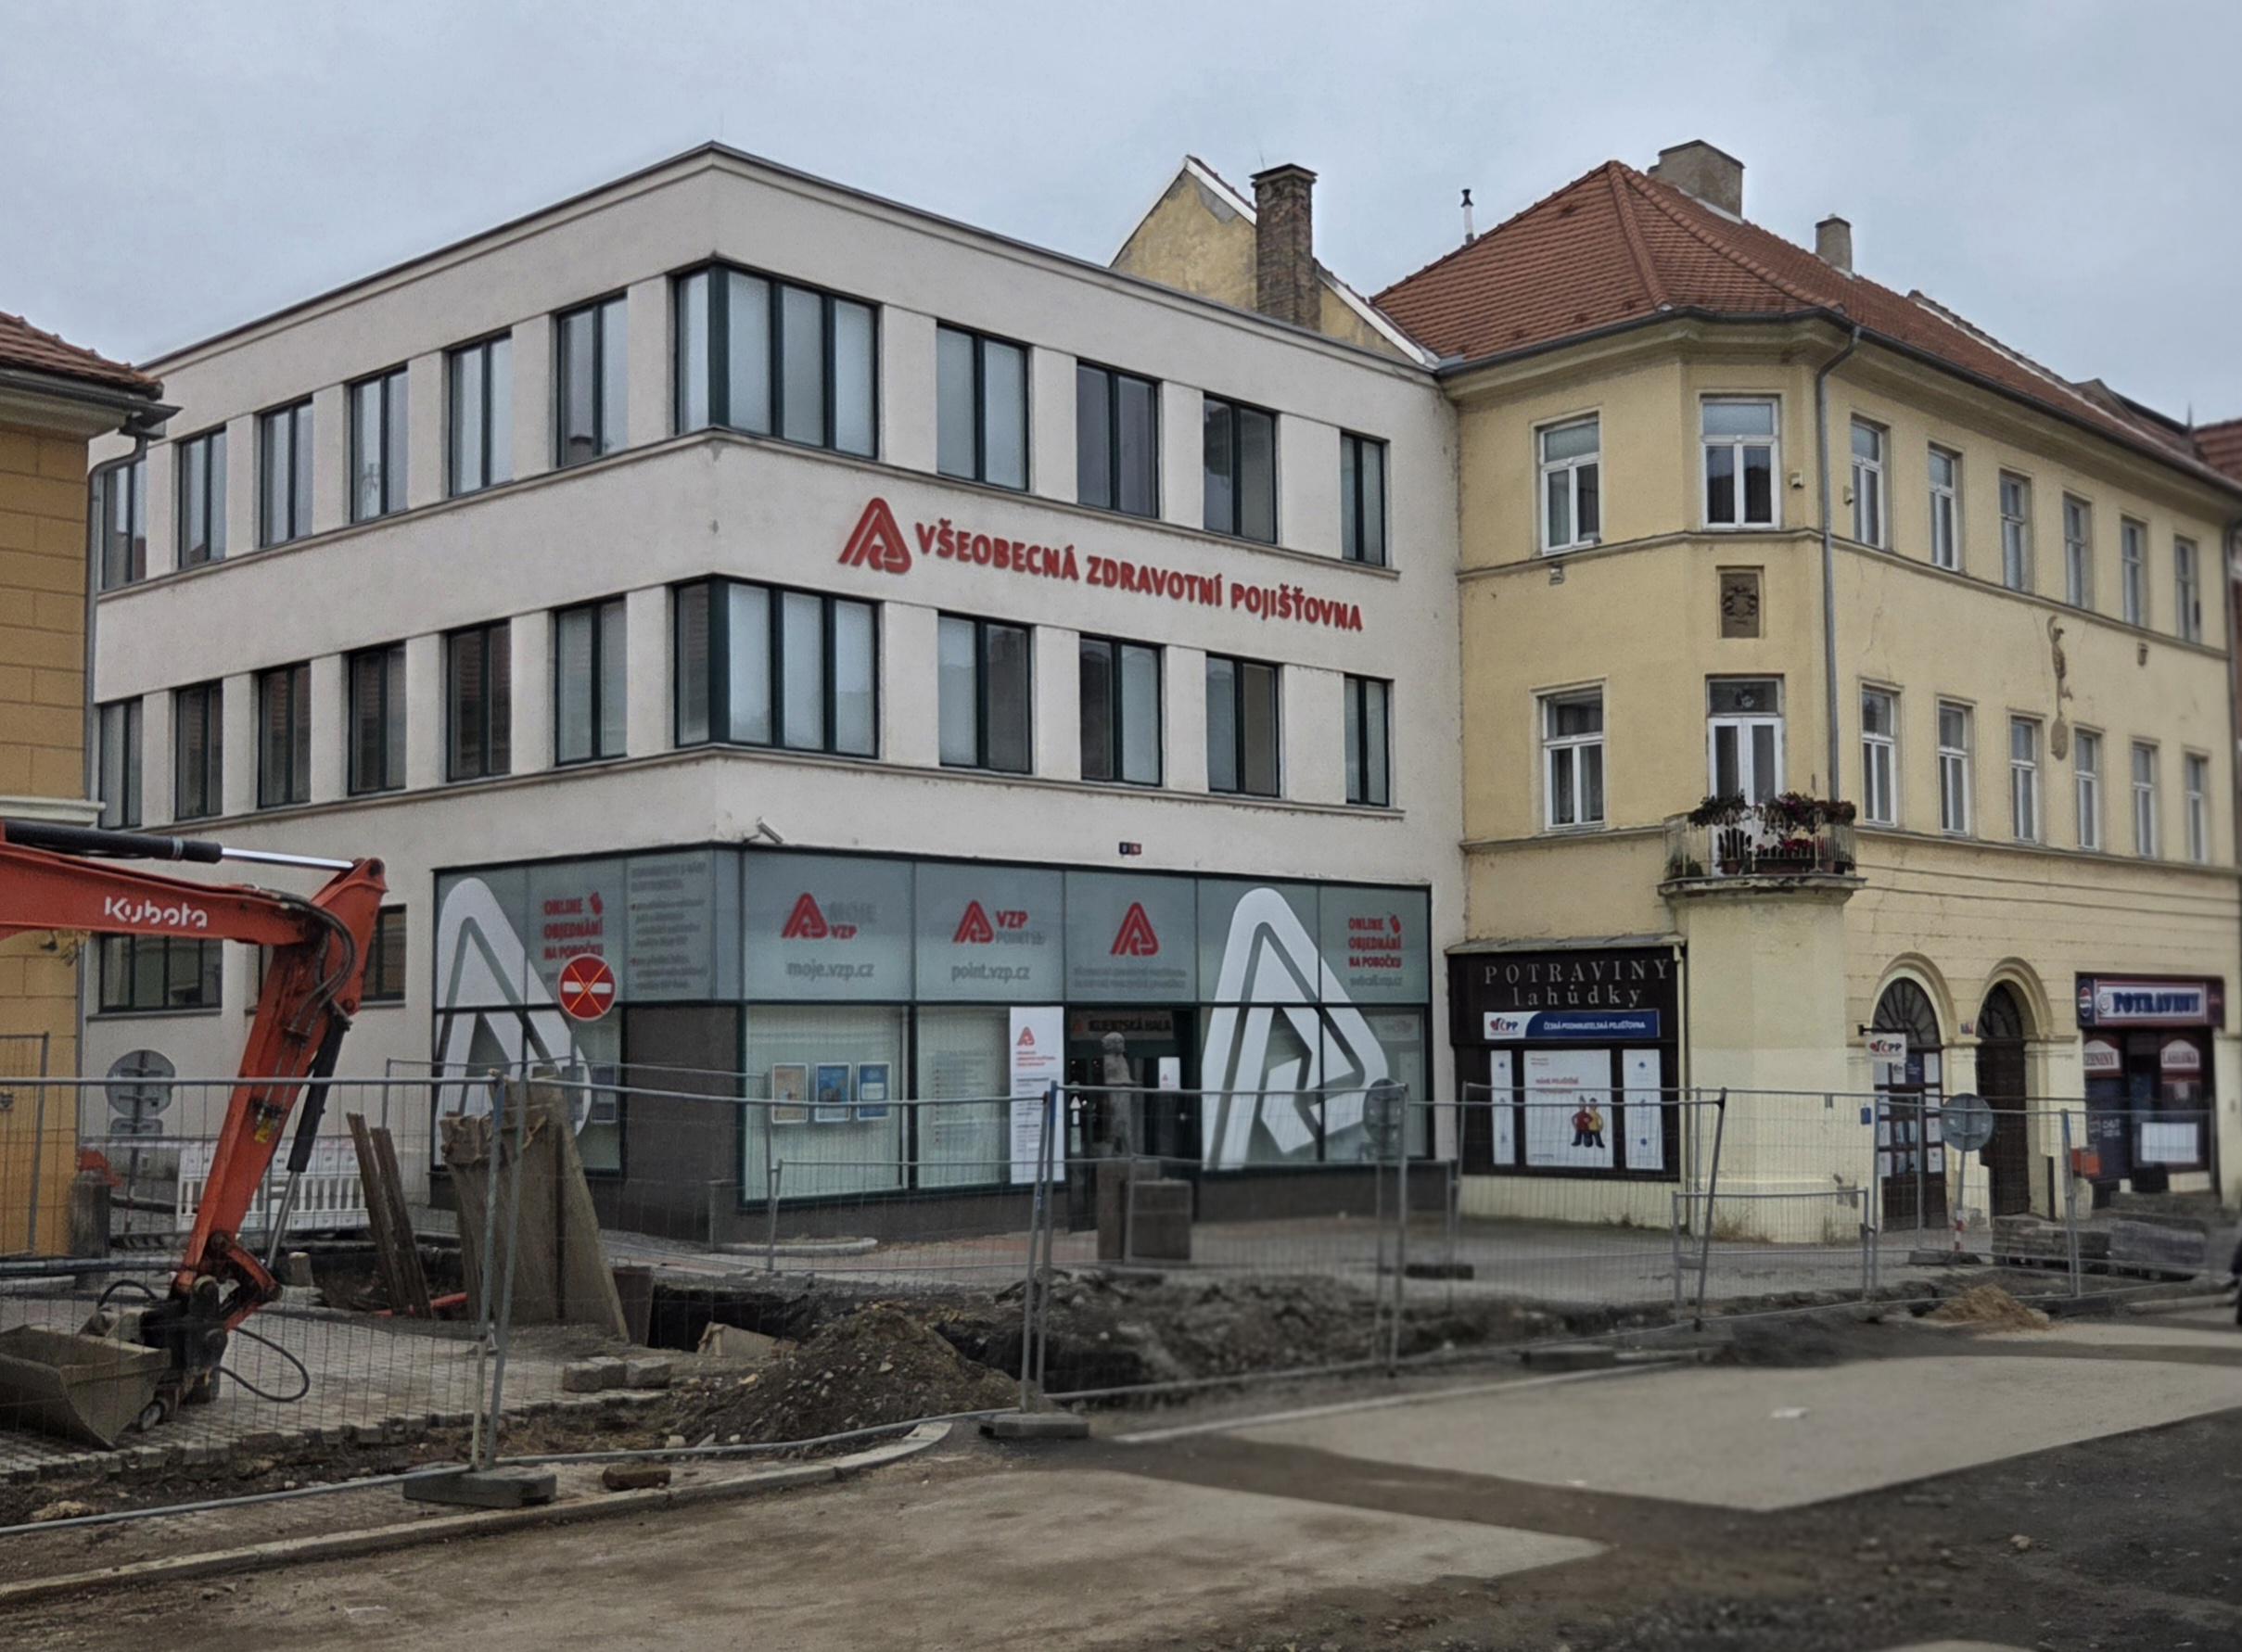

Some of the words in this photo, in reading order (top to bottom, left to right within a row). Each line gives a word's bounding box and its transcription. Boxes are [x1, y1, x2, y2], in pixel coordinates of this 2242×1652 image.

[915, 517, 1079, 581] VŠEOBECNÁ
[1087, 554, 1223, 607] ZDRAVOTNÍ
[1230, 583, 1363, 631] POJIŠŤOVNA
[104, 896, 208, 928] Kubota
[996, 910, 1029, 929] VZP
[830, 925, 858, 939] VZP
[1349, 918, 1384, 931] ONLINE
[787, 959, 874, 981] moje.vzp.cz
[951, 962, 1031, 984] point.vzp.cz
[1484, 959, 1668, 985] POTRAVINY
[2112, 992, 2199, 1014] POTRAVINY
